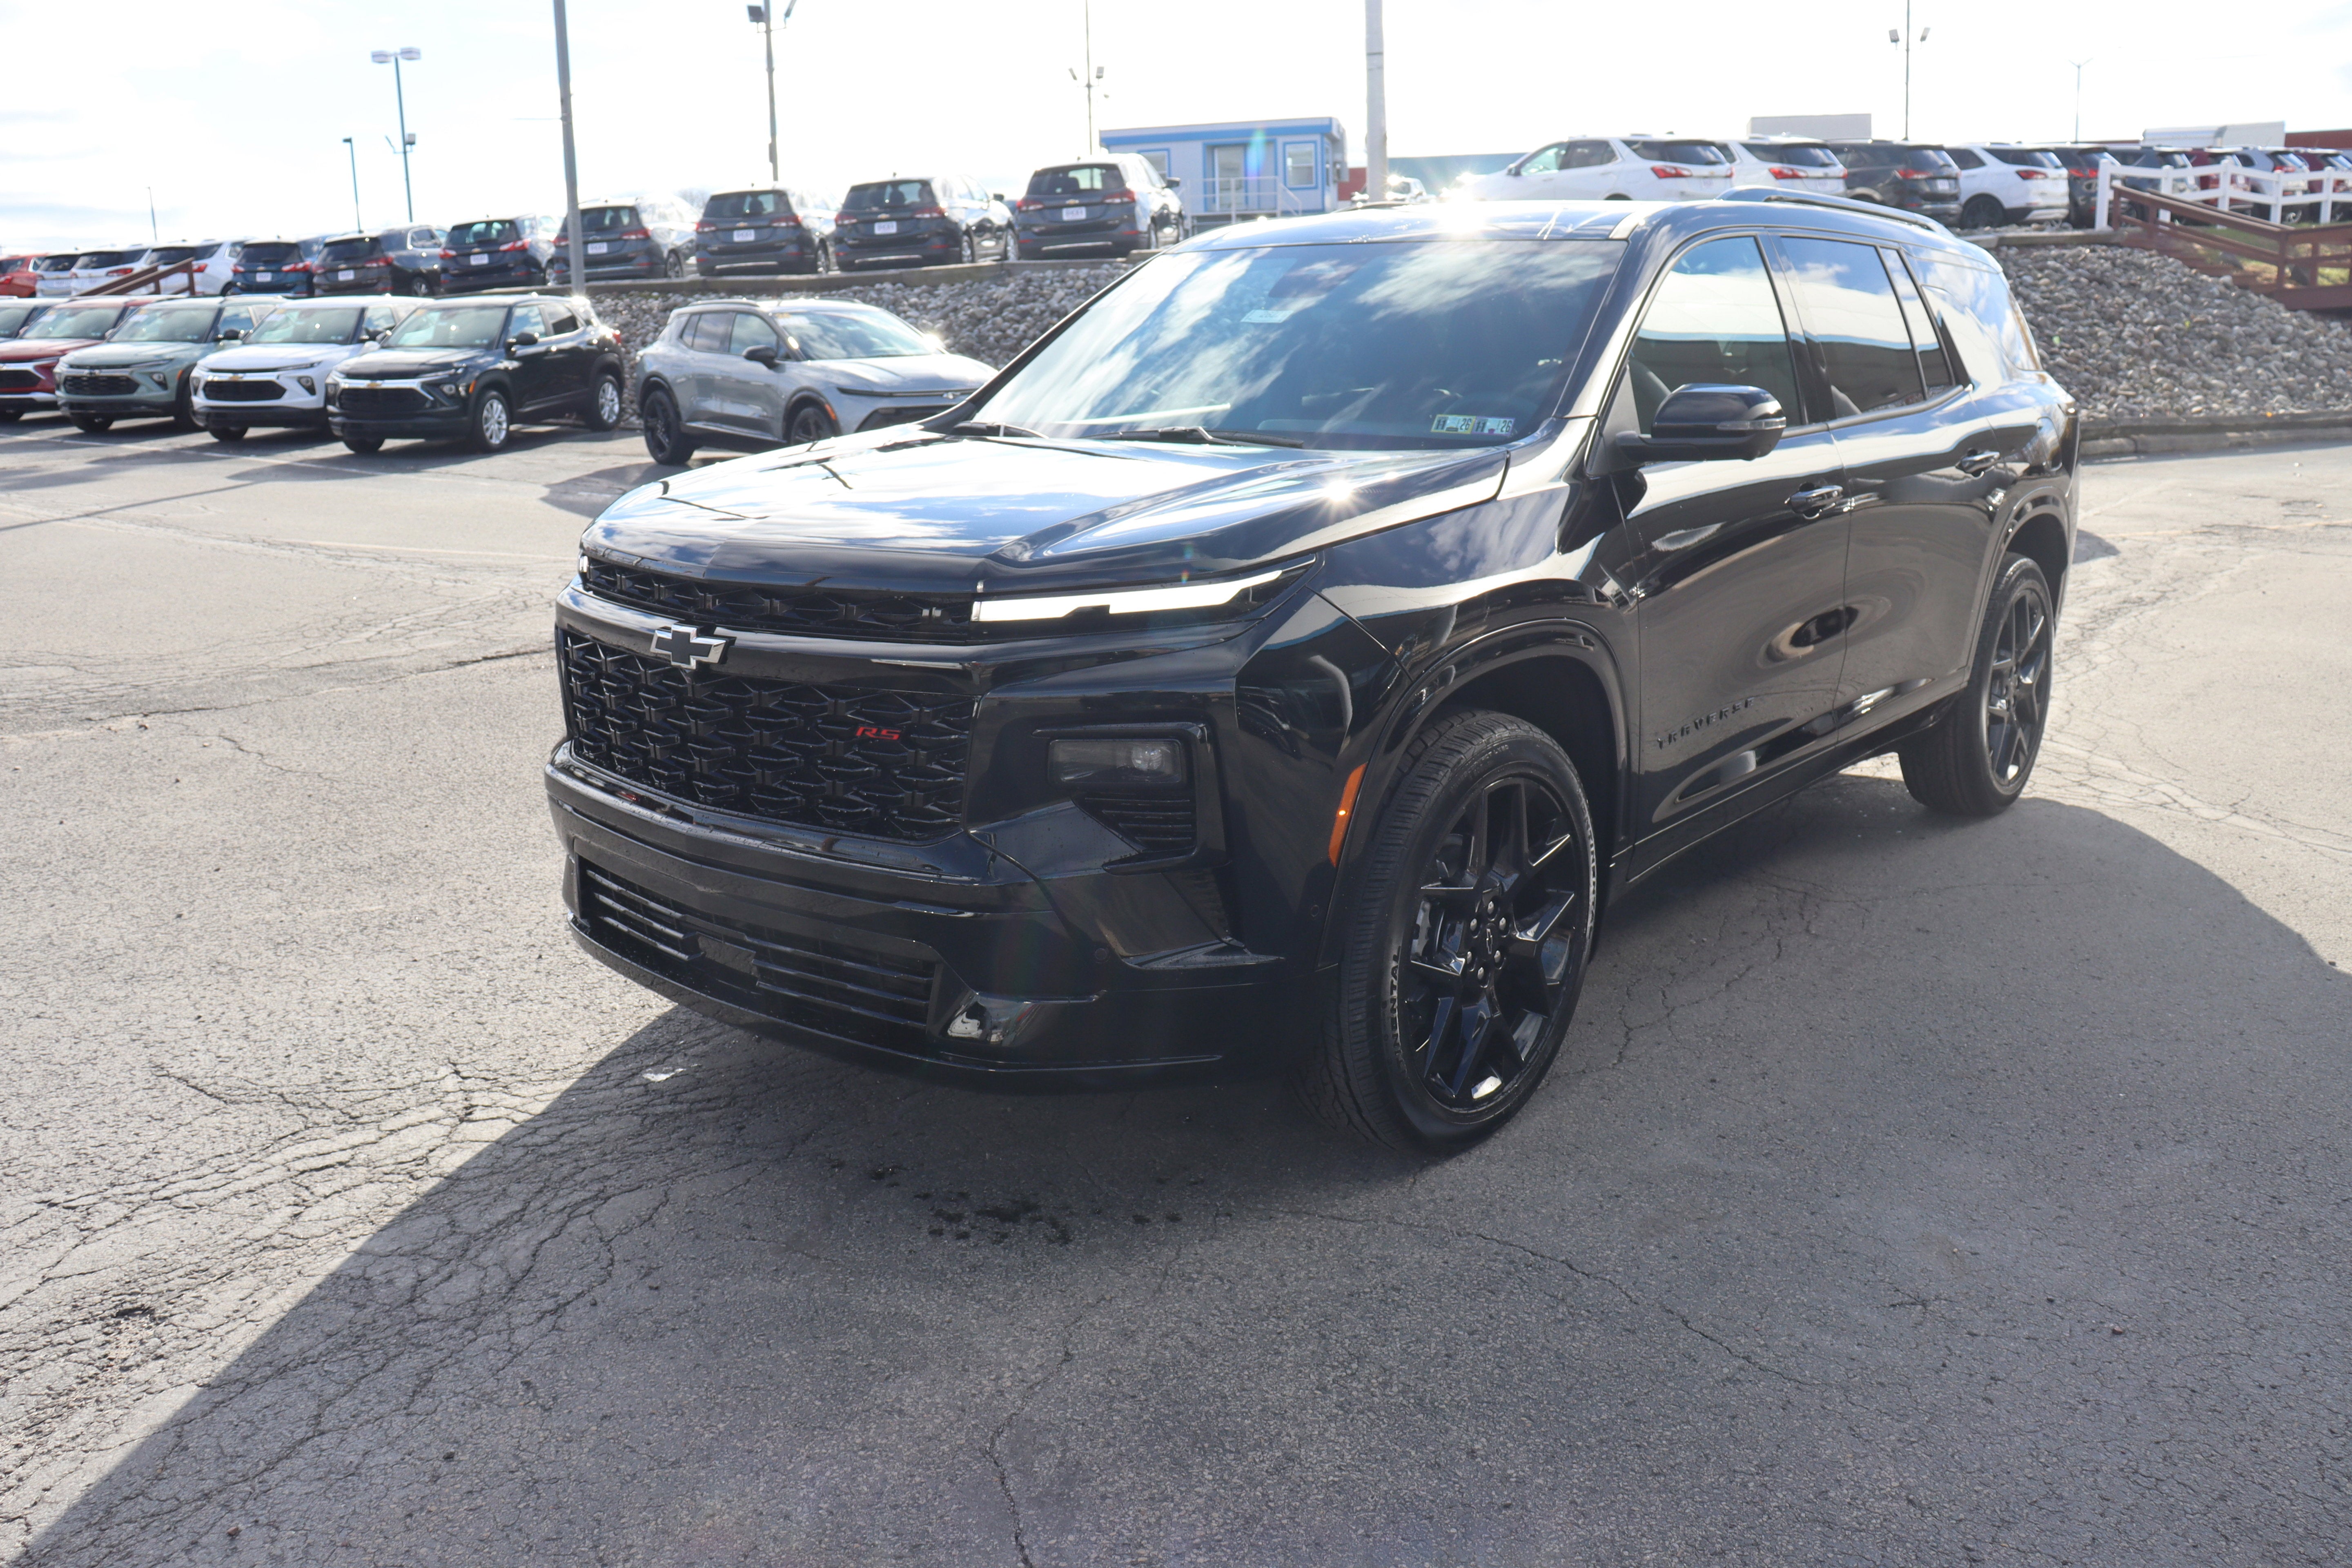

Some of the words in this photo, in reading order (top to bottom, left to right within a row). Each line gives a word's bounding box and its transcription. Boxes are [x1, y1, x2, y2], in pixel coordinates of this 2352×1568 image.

[1436, 419, 1446, 430] 11
[1459, 418, 1472, 430] 26
[1475, 421, 1486, 432] 11
[1500, 420, 1512, 432] 26
[856, 726, 901, 740] RS
[1390, 945, 1407, 1074] TINENTAL
